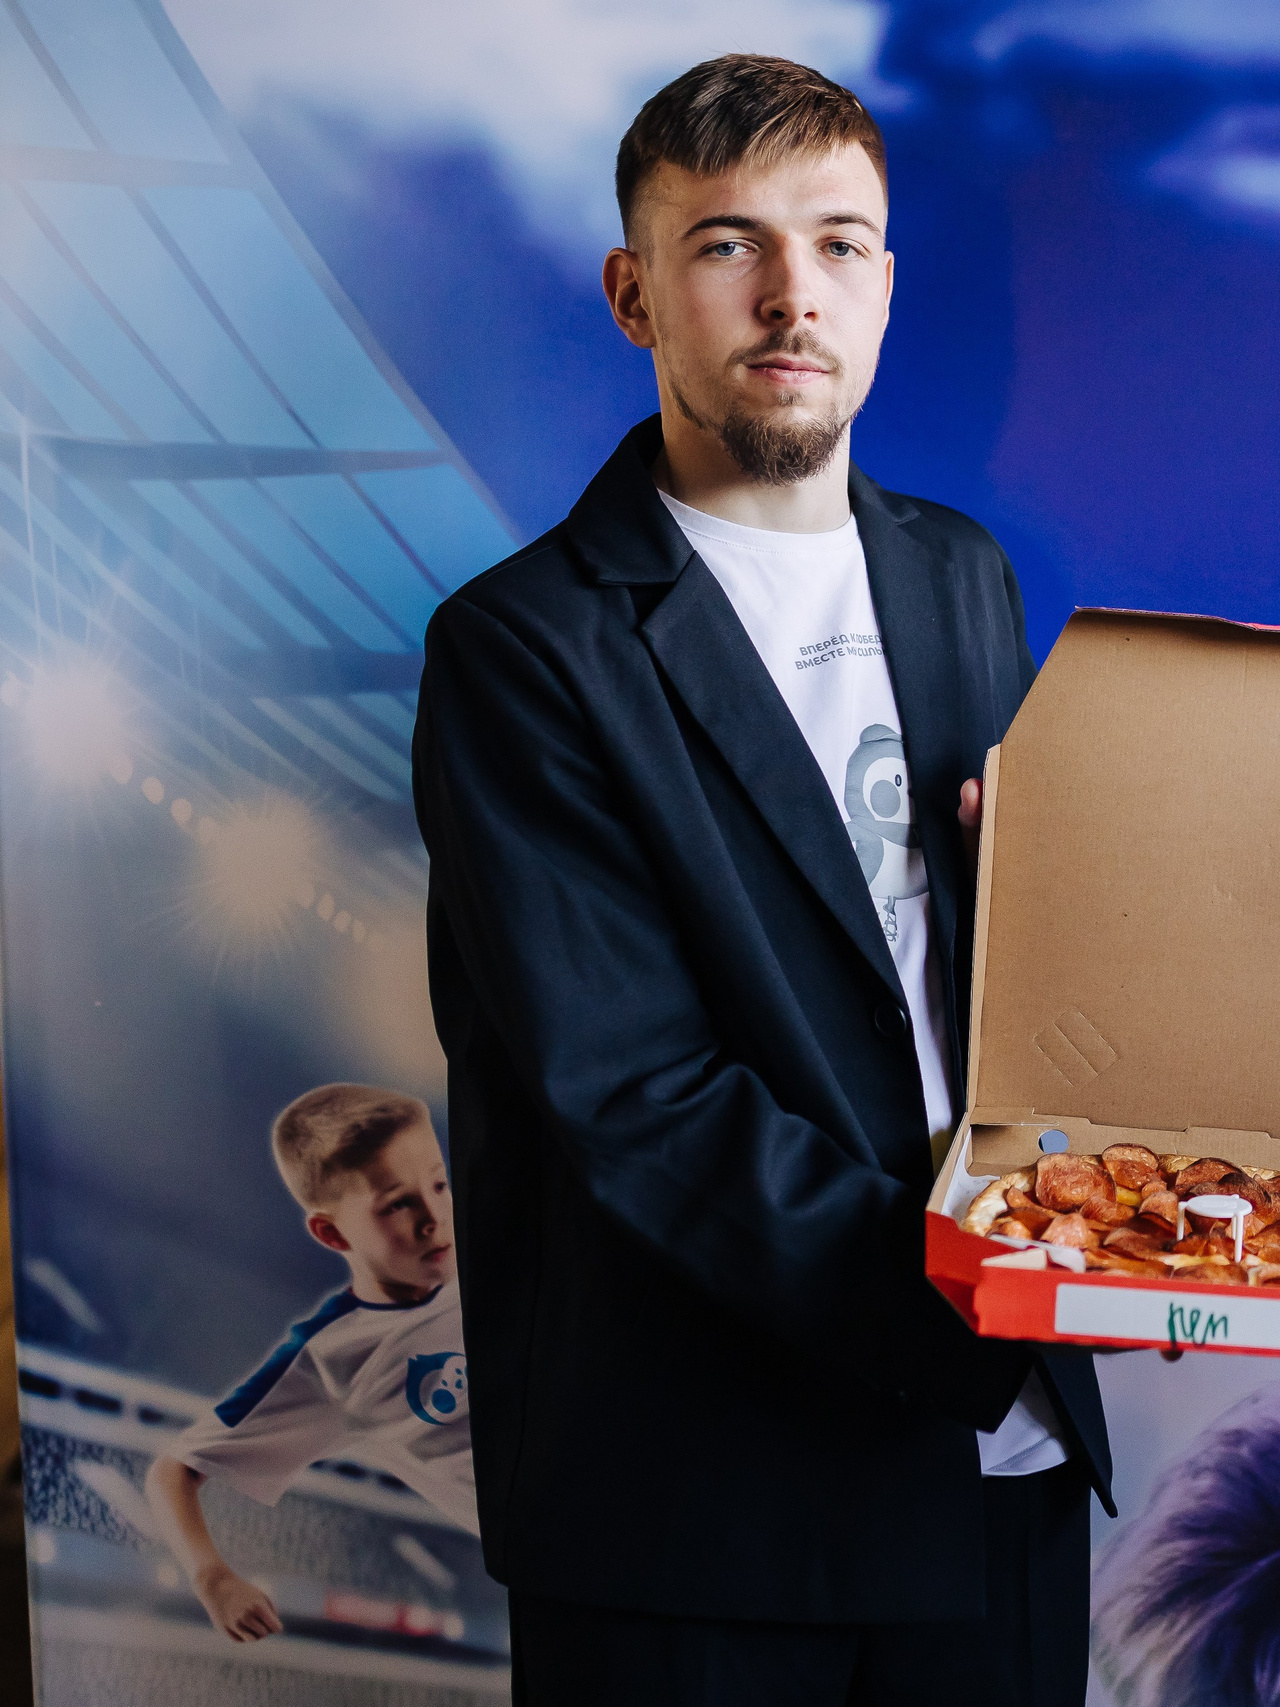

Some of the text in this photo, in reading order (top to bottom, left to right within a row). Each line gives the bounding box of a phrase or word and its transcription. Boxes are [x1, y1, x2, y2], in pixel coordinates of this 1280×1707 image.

[799, 635, 850, 656] ВПЕРЁД
[795, 648, 846, 670] ВМЕСТЕ
[858, 647, 883, 657] СИЛЬ
